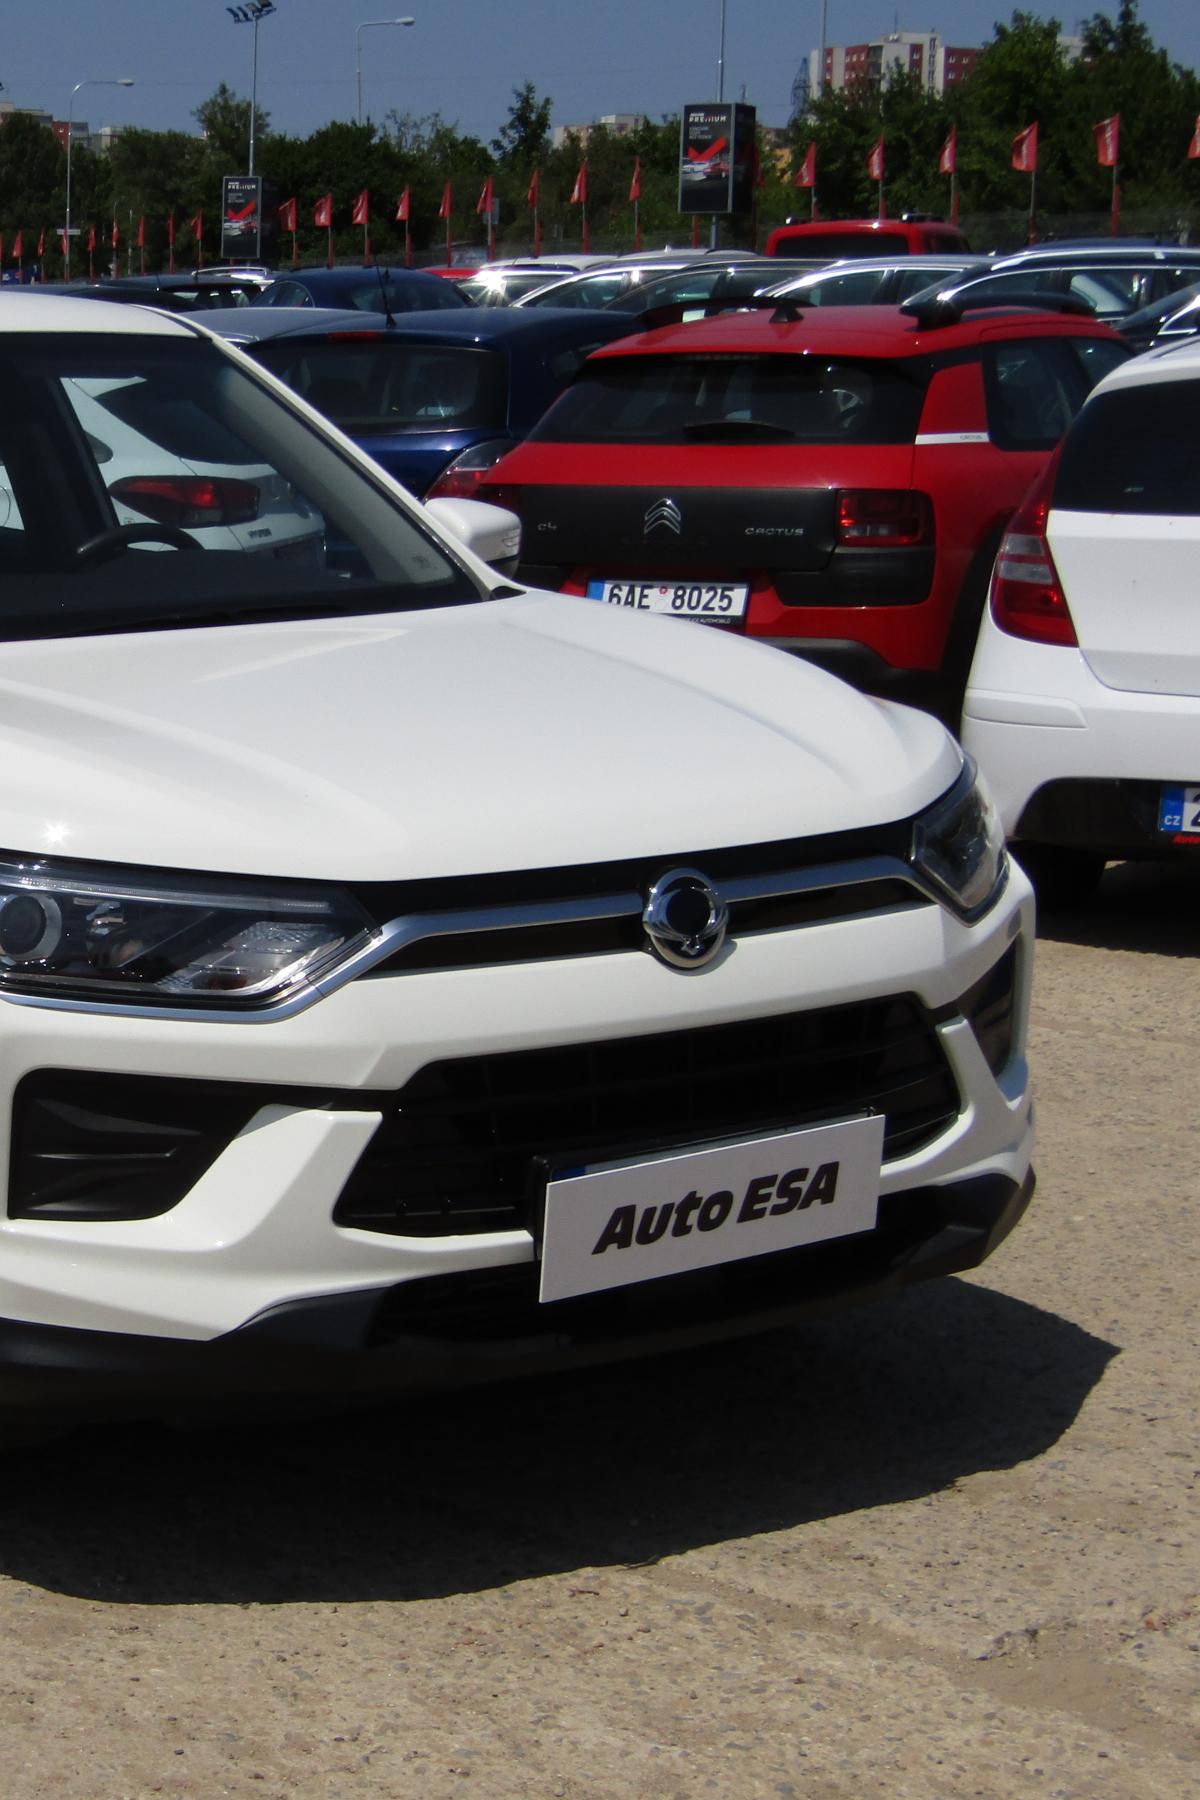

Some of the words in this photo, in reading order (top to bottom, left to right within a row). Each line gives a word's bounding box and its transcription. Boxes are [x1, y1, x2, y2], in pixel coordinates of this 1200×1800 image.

[745, 527, 804, 536] CACTUS
[608, 584, 654, 610] 6AE
[671, 585, 735, 613] 8025
[1164, 815, 1181, 826] CZ
[591, 1190, 734, 1256] Auto
[736, 1161, 840, 1224] ESA
